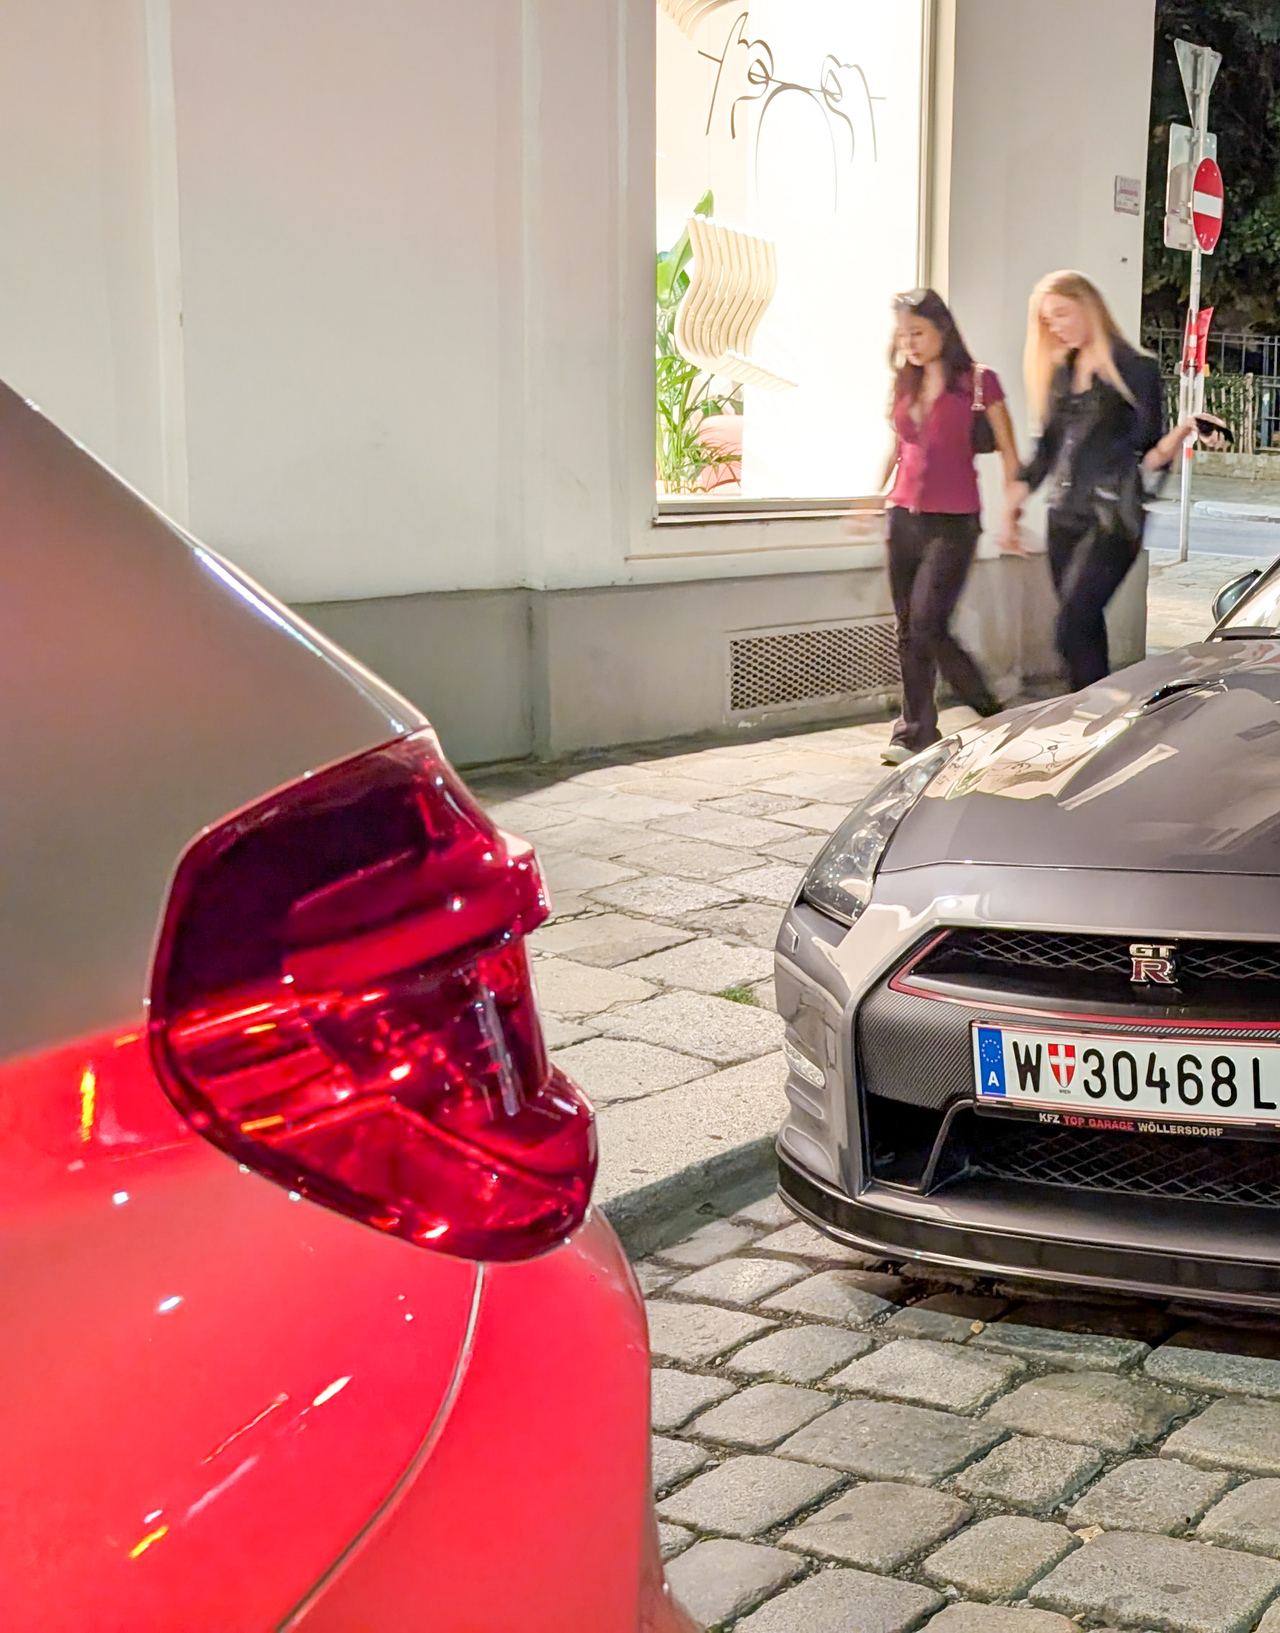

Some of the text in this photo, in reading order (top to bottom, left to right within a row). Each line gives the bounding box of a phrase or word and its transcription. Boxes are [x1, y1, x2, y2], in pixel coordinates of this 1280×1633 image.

[1129, 943, 1176, 958] GT
[1130, 957, 1179, 984] R
[987, 1071, 1000, 1087] A
[1012, 1041, 1043, 1093] W
[1038, 1112, 1224, 1137] KFZ TOP GARAGE WÖLLERSDORF
